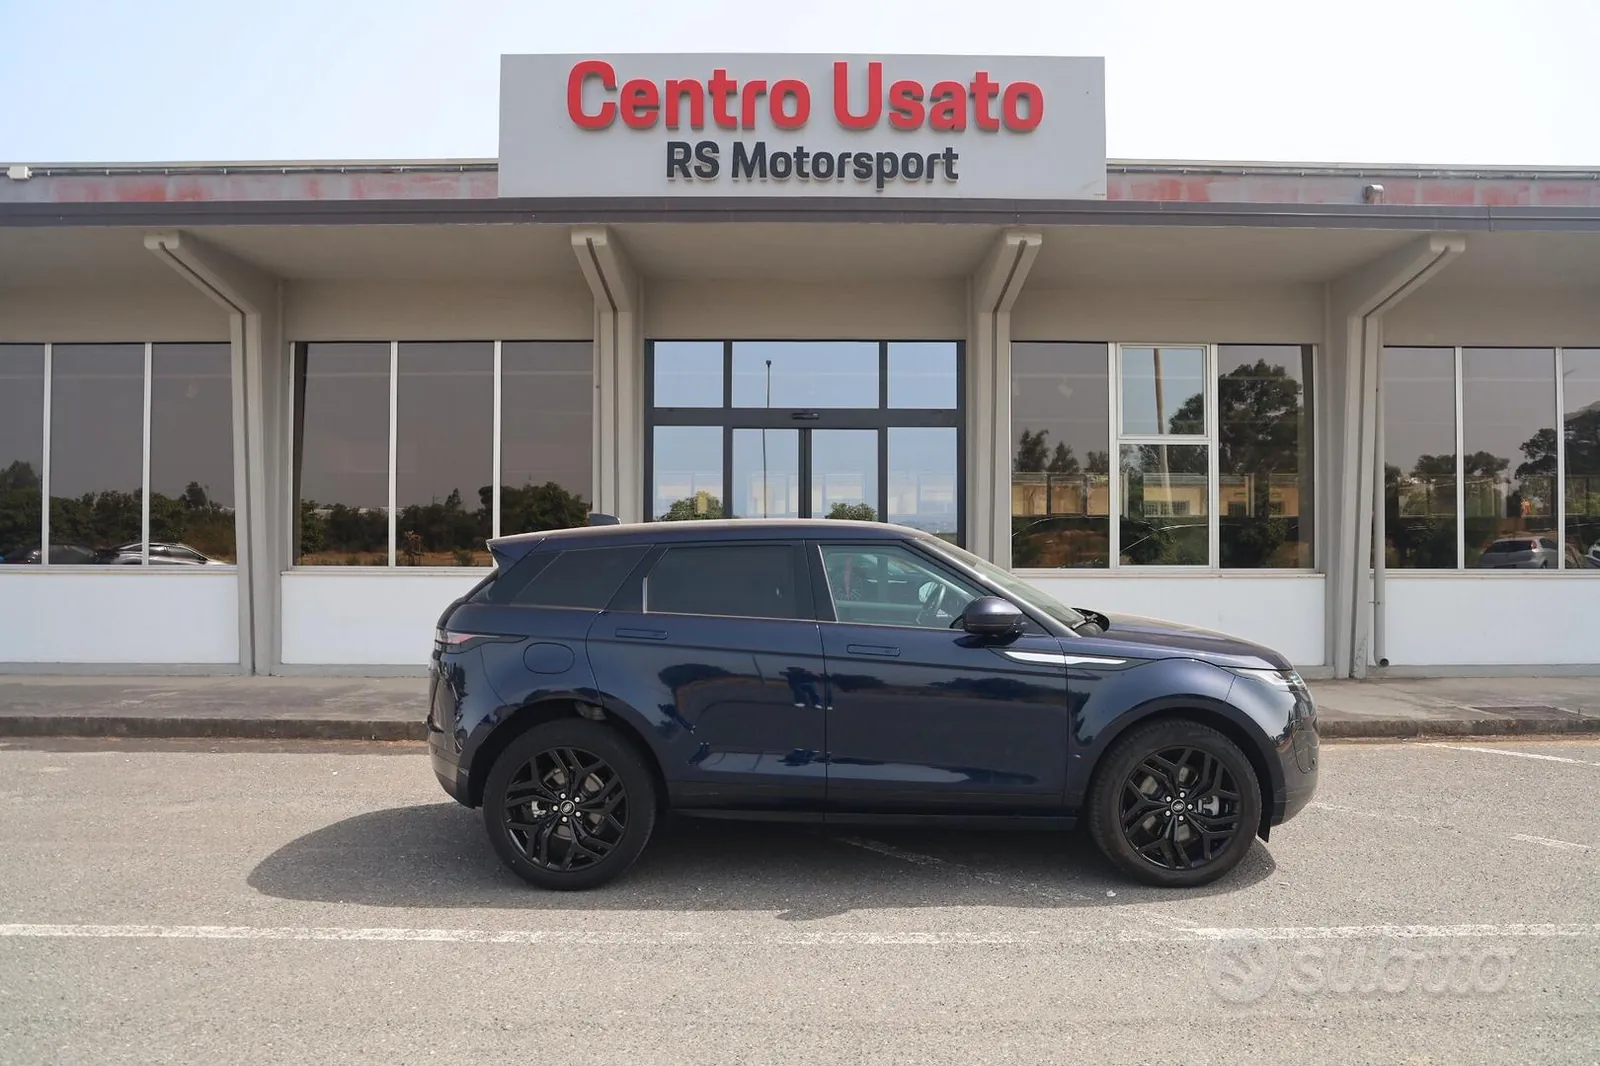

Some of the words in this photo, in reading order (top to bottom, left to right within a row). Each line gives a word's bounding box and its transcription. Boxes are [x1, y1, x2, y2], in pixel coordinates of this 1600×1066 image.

[567, 60, 811, 130] Centro
[833, 62, 1044, 132] Usato
[667, 140, 720, 181] RS
[732, 140, 959, 190] Motorsport
